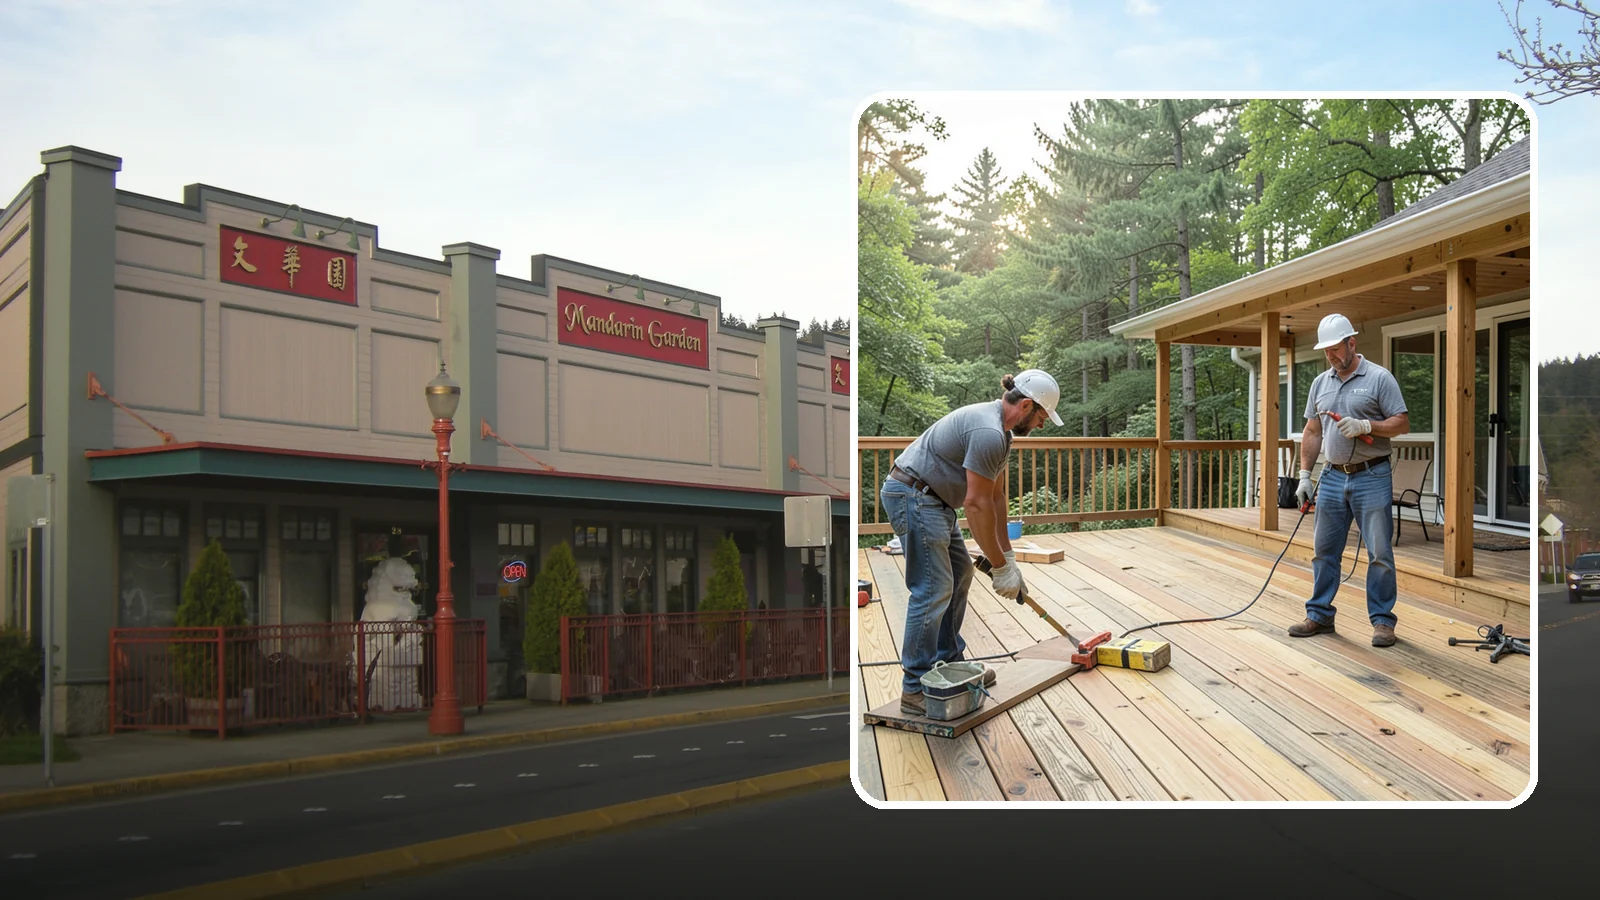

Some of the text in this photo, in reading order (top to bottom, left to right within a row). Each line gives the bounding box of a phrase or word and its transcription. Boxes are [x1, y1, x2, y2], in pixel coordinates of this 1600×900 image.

[230, 235, 347, 291] 文華園
[564, 302, 702, 352] Mandarin Garden
[503, 565, 527, 578] OPEN
